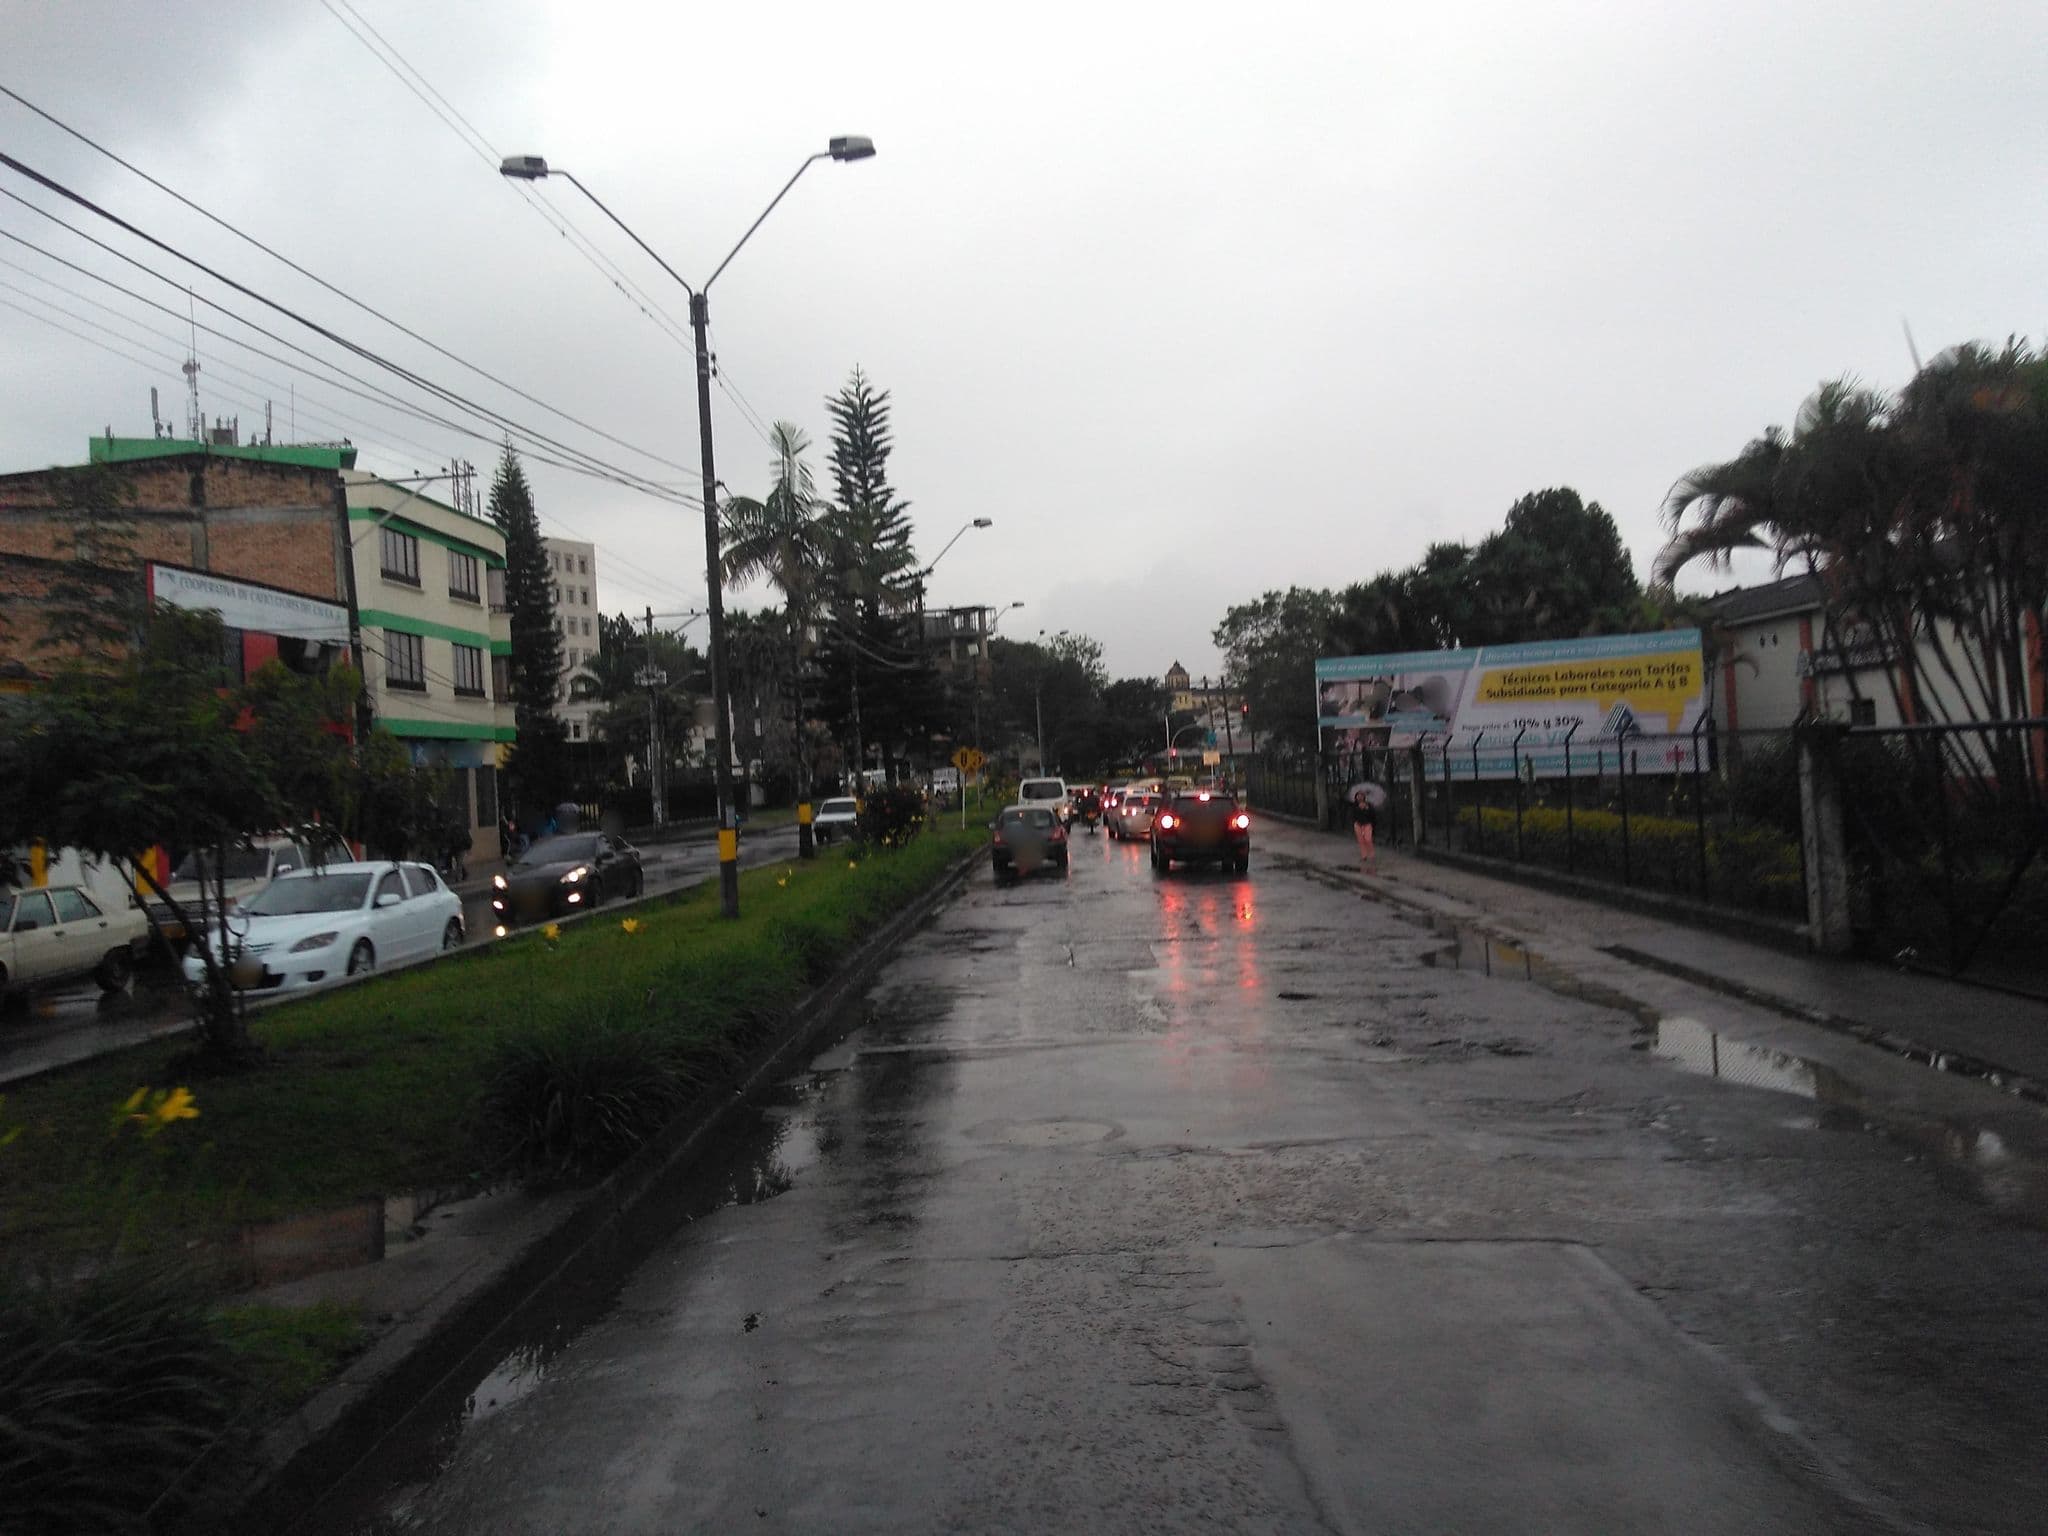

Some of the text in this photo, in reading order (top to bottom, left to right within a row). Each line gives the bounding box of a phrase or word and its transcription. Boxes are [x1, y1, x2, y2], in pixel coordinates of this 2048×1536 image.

[1502, 664, 1690, 685] Técnicos Laborales con Tarifas
[1487, 686, 1556, 698] Subsidiadas
[1560, 684, 1587, 697] para
[1654, 678, 1664, 688] A
[1679, 676, 1688, 687] B
[1513, 718, 1540, 729] 10%
[1544, 718, 1551, 729] y
[1555, 715, 1584, 728] 30%
